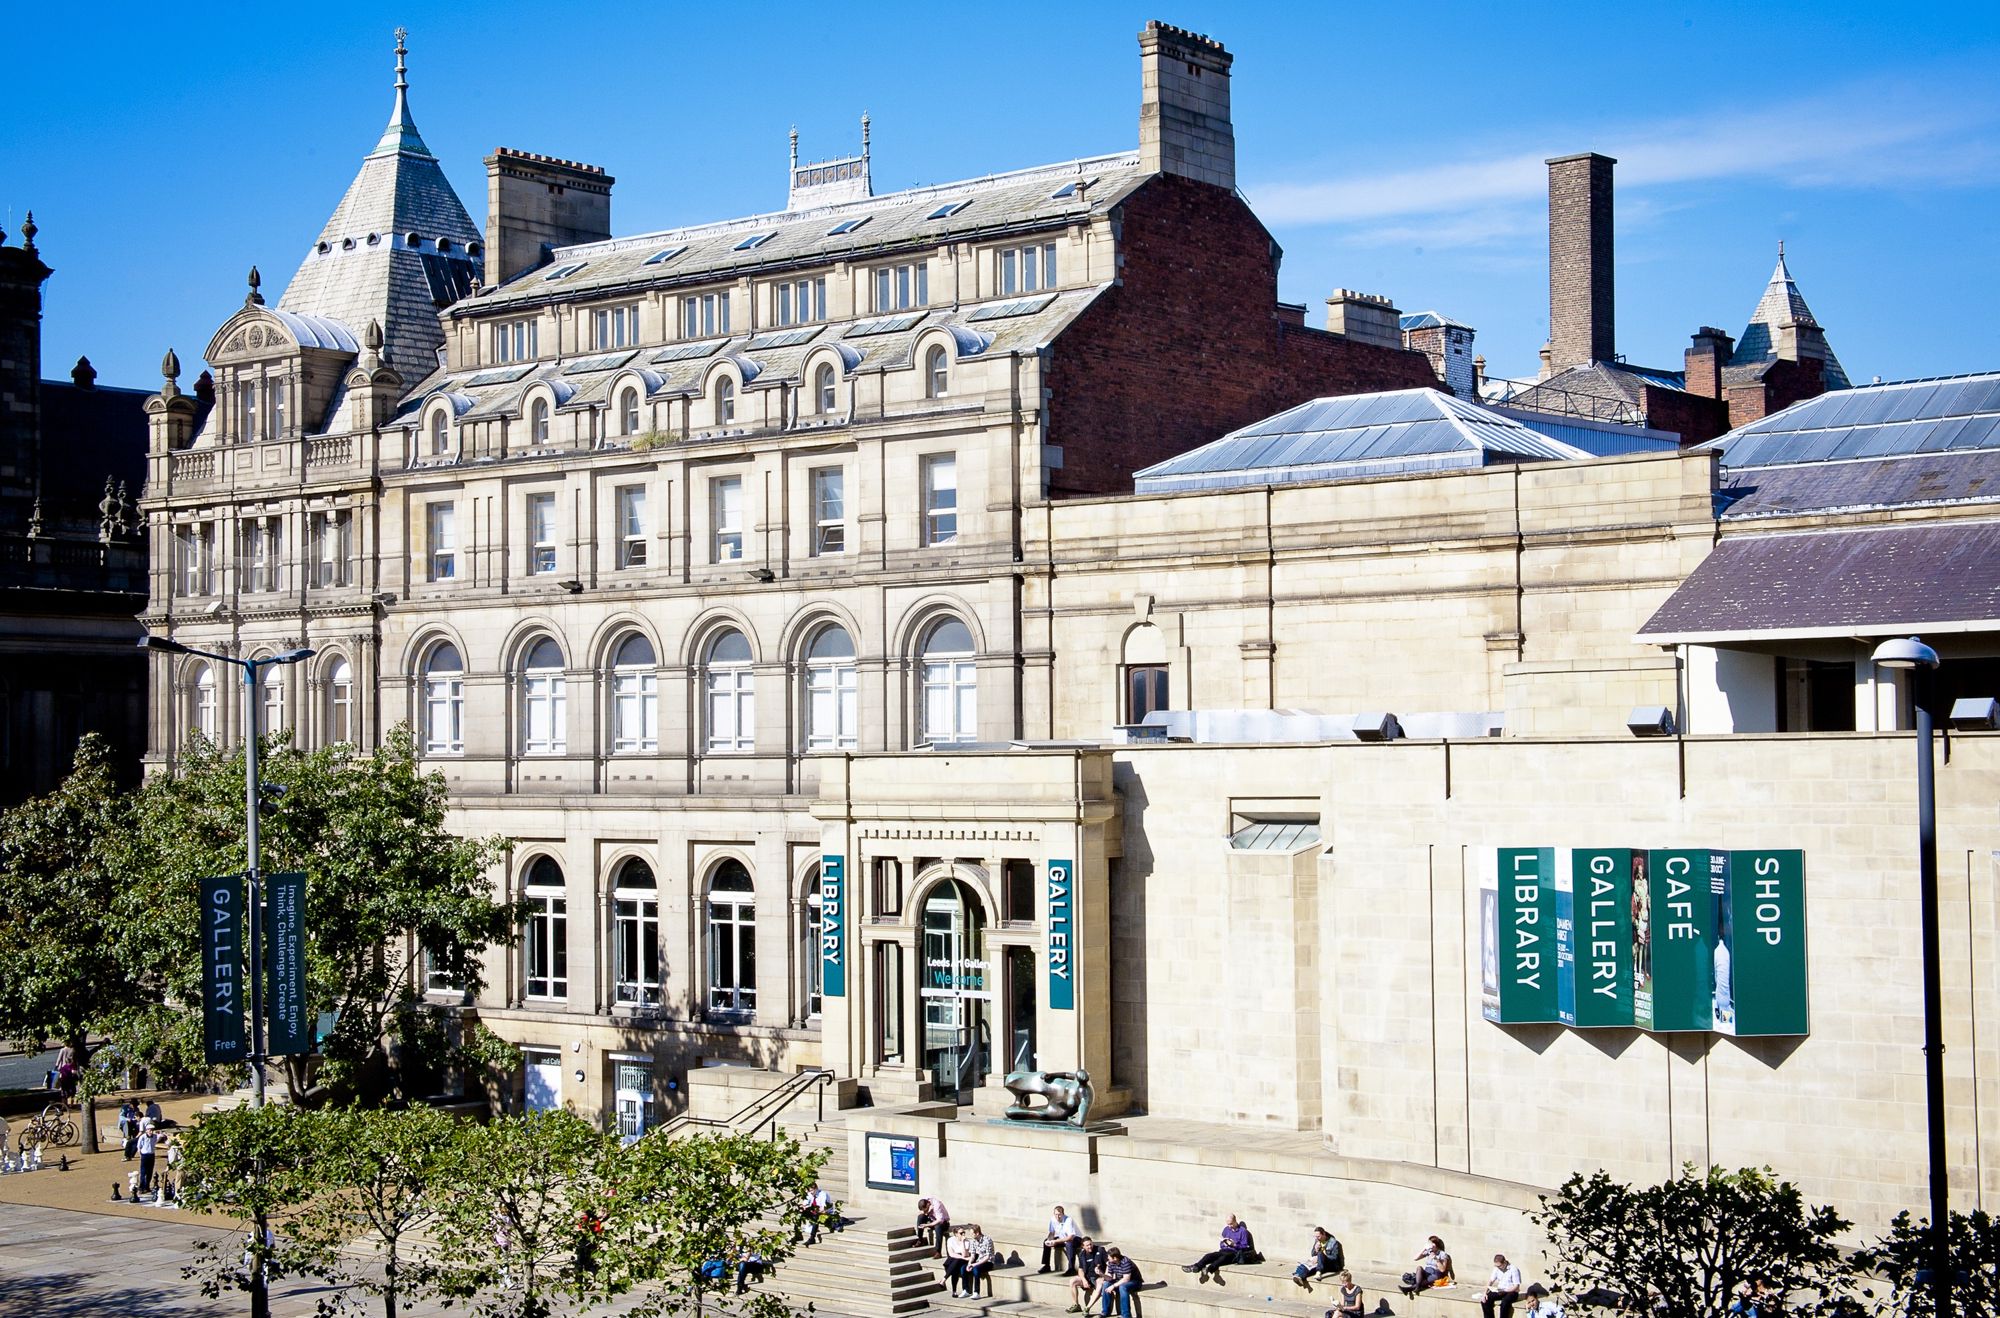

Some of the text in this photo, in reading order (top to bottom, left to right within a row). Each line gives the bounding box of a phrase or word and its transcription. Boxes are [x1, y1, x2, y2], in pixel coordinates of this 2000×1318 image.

[213, 889, 233, 1015] GALLERY
[277, 885, 287, 1020] Think, Challenge, Create
[822, 861, 839, 965] LIBRARY
[1049, 866, 1068, 980] GALLERY
[1514, 854, 1541, 990] LIBRARY
[1590, 855, 1617, 1000] GALLERY
[1665, 856, 1700, 940] CAFÉ
[1754, 857, 1782, 946] SHOP
[287, 884, 298, 1038] Imagine, Experiment, Enjoy,
[927, 956, 950, 968] Leeds
[964, 958, 992, 971] Gallery
[934, 970, 984, 986] Welcome
[215, 1039, 237, 1051] Free
